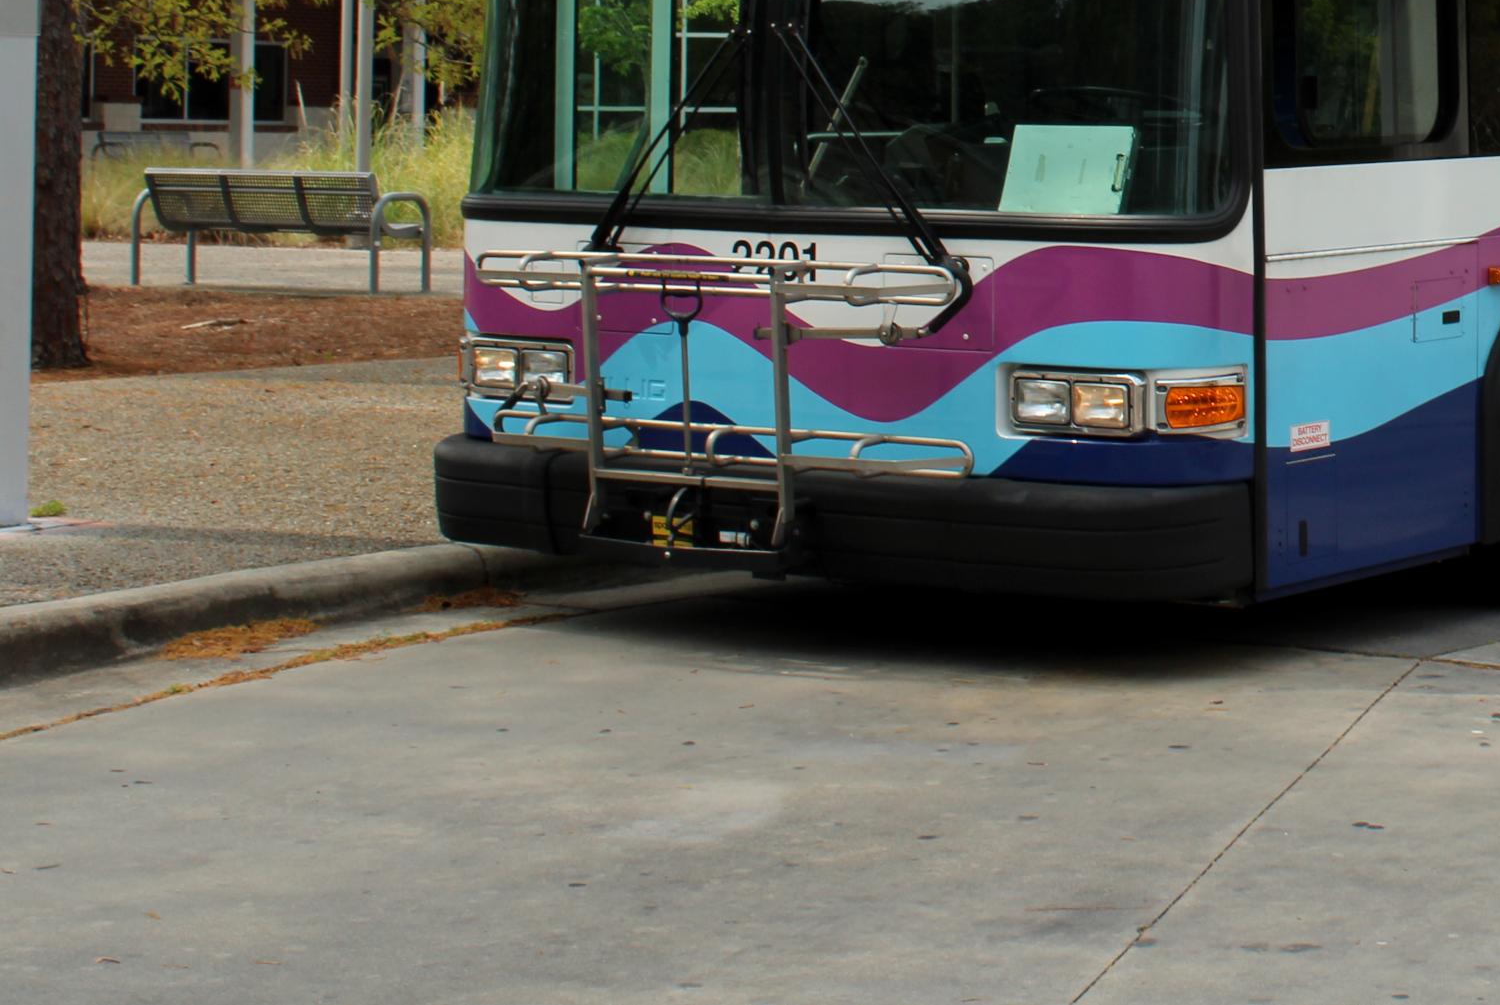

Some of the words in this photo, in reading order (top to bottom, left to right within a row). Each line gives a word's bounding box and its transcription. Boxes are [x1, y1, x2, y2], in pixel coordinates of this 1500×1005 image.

[732, 240, 817, 282] 2201
[1298, 425, 1321, 436] BATTERY
[1292, 433, 1328, 447] DISCONNECT
